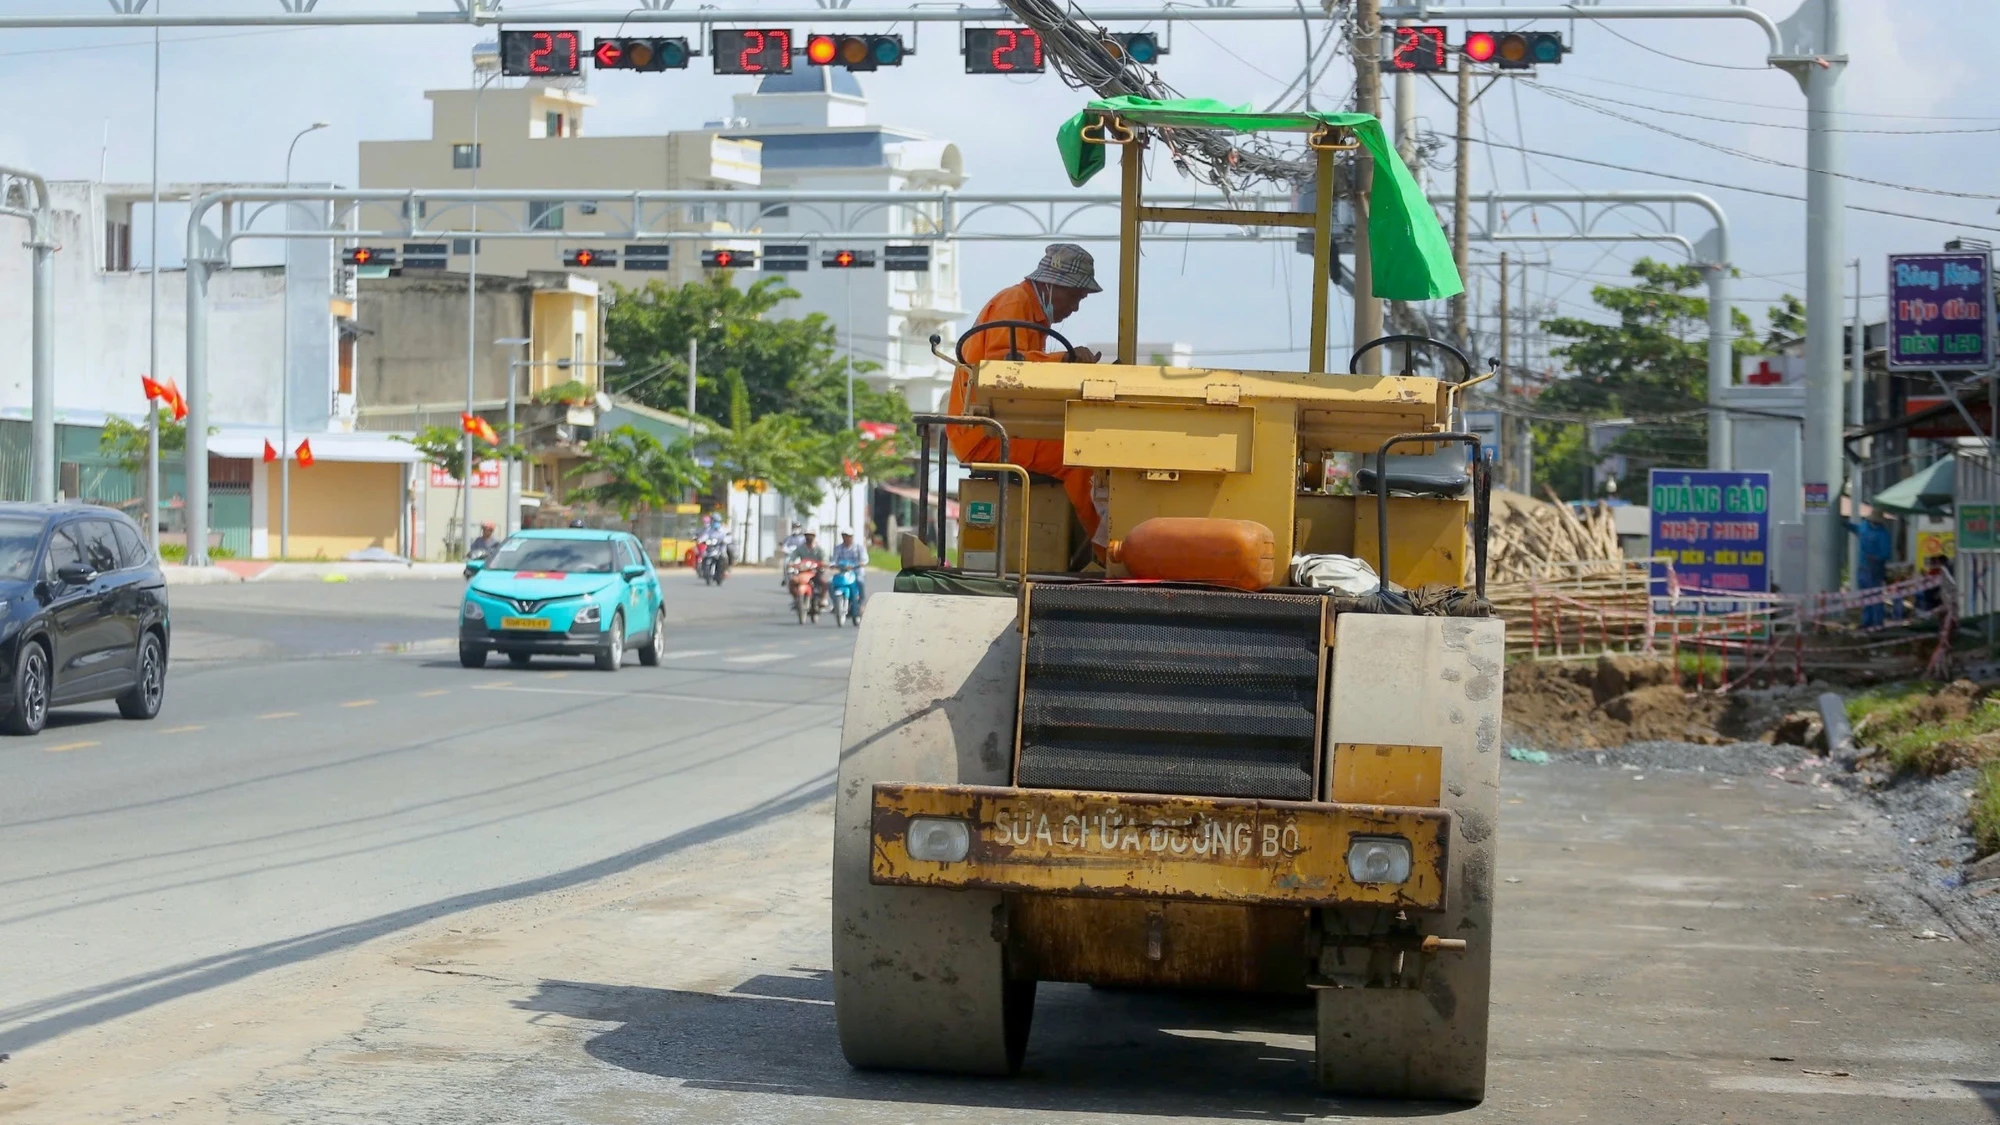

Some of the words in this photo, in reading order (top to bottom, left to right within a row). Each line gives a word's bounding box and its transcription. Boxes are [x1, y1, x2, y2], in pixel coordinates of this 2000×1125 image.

[529, 32, 578, 72] 27
[740, 30, 788, 72] 27
[991, 28, 1042, 70] 27
[1393, 26, 1444, 70] 27
[1943, 333, 1981, 354] LED
[1652, 476, 1721, 515] QUẢNG
[1712, 521, 1760, 542] MINH
[994, 801, 1053, 847] SỬA
[1062, 808, 1142, 851] CHỮA
